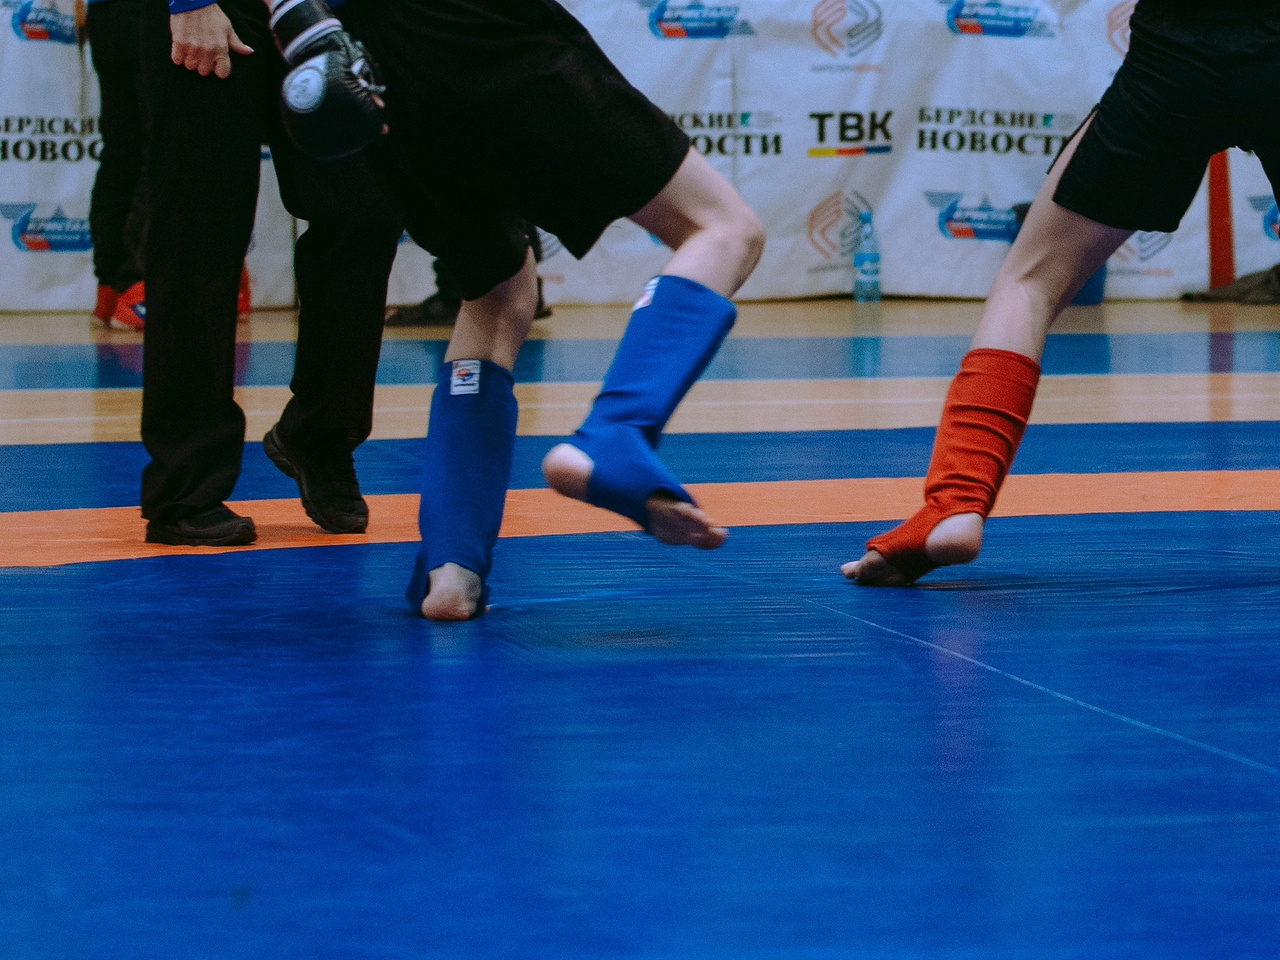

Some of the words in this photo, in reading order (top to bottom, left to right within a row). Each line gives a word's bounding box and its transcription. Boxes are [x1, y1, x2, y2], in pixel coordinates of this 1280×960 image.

[0, 116, 101, 137] ЕРДСКИ
[809, 111, 893, 143] ТВК
[918, 107, 1038, 129] БЕРДСКИЕ
[0, 139, 104, 162] ОВОС
[690, 134, 782, 156] ОСТИ
